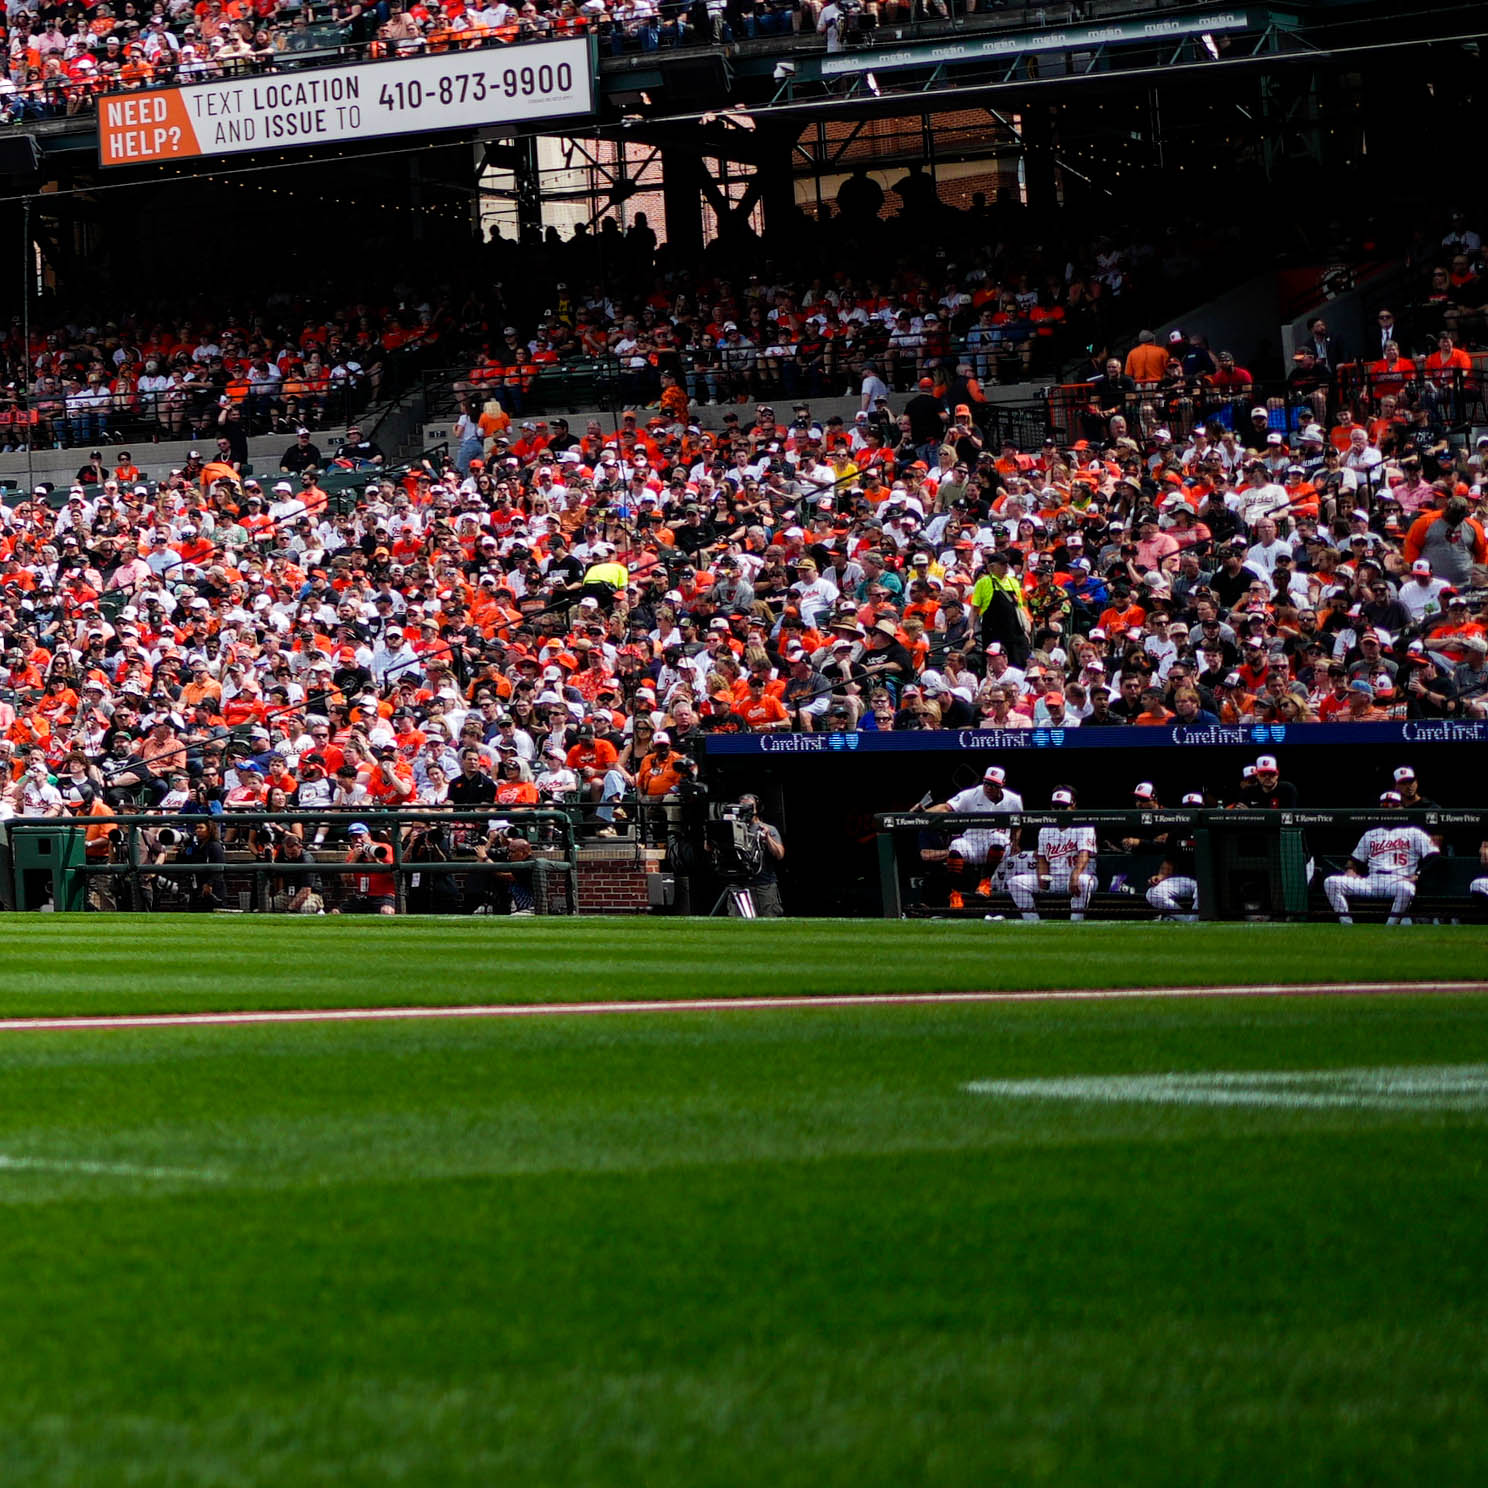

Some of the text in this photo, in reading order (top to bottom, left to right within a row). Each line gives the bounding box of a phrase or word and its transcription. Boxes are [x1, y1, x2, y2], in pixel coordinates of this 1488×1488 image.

[192, 75, 360, 118] TEXT LOCATION
[378, 61, 572, 112] 410-873-9900
[107, 96, 168, 128] NEED
[214, 105, 361, 145] AND ISSUE TO
[110, 126, 182, 159] HELP?
[1393, 853, 1408, 867] 15
